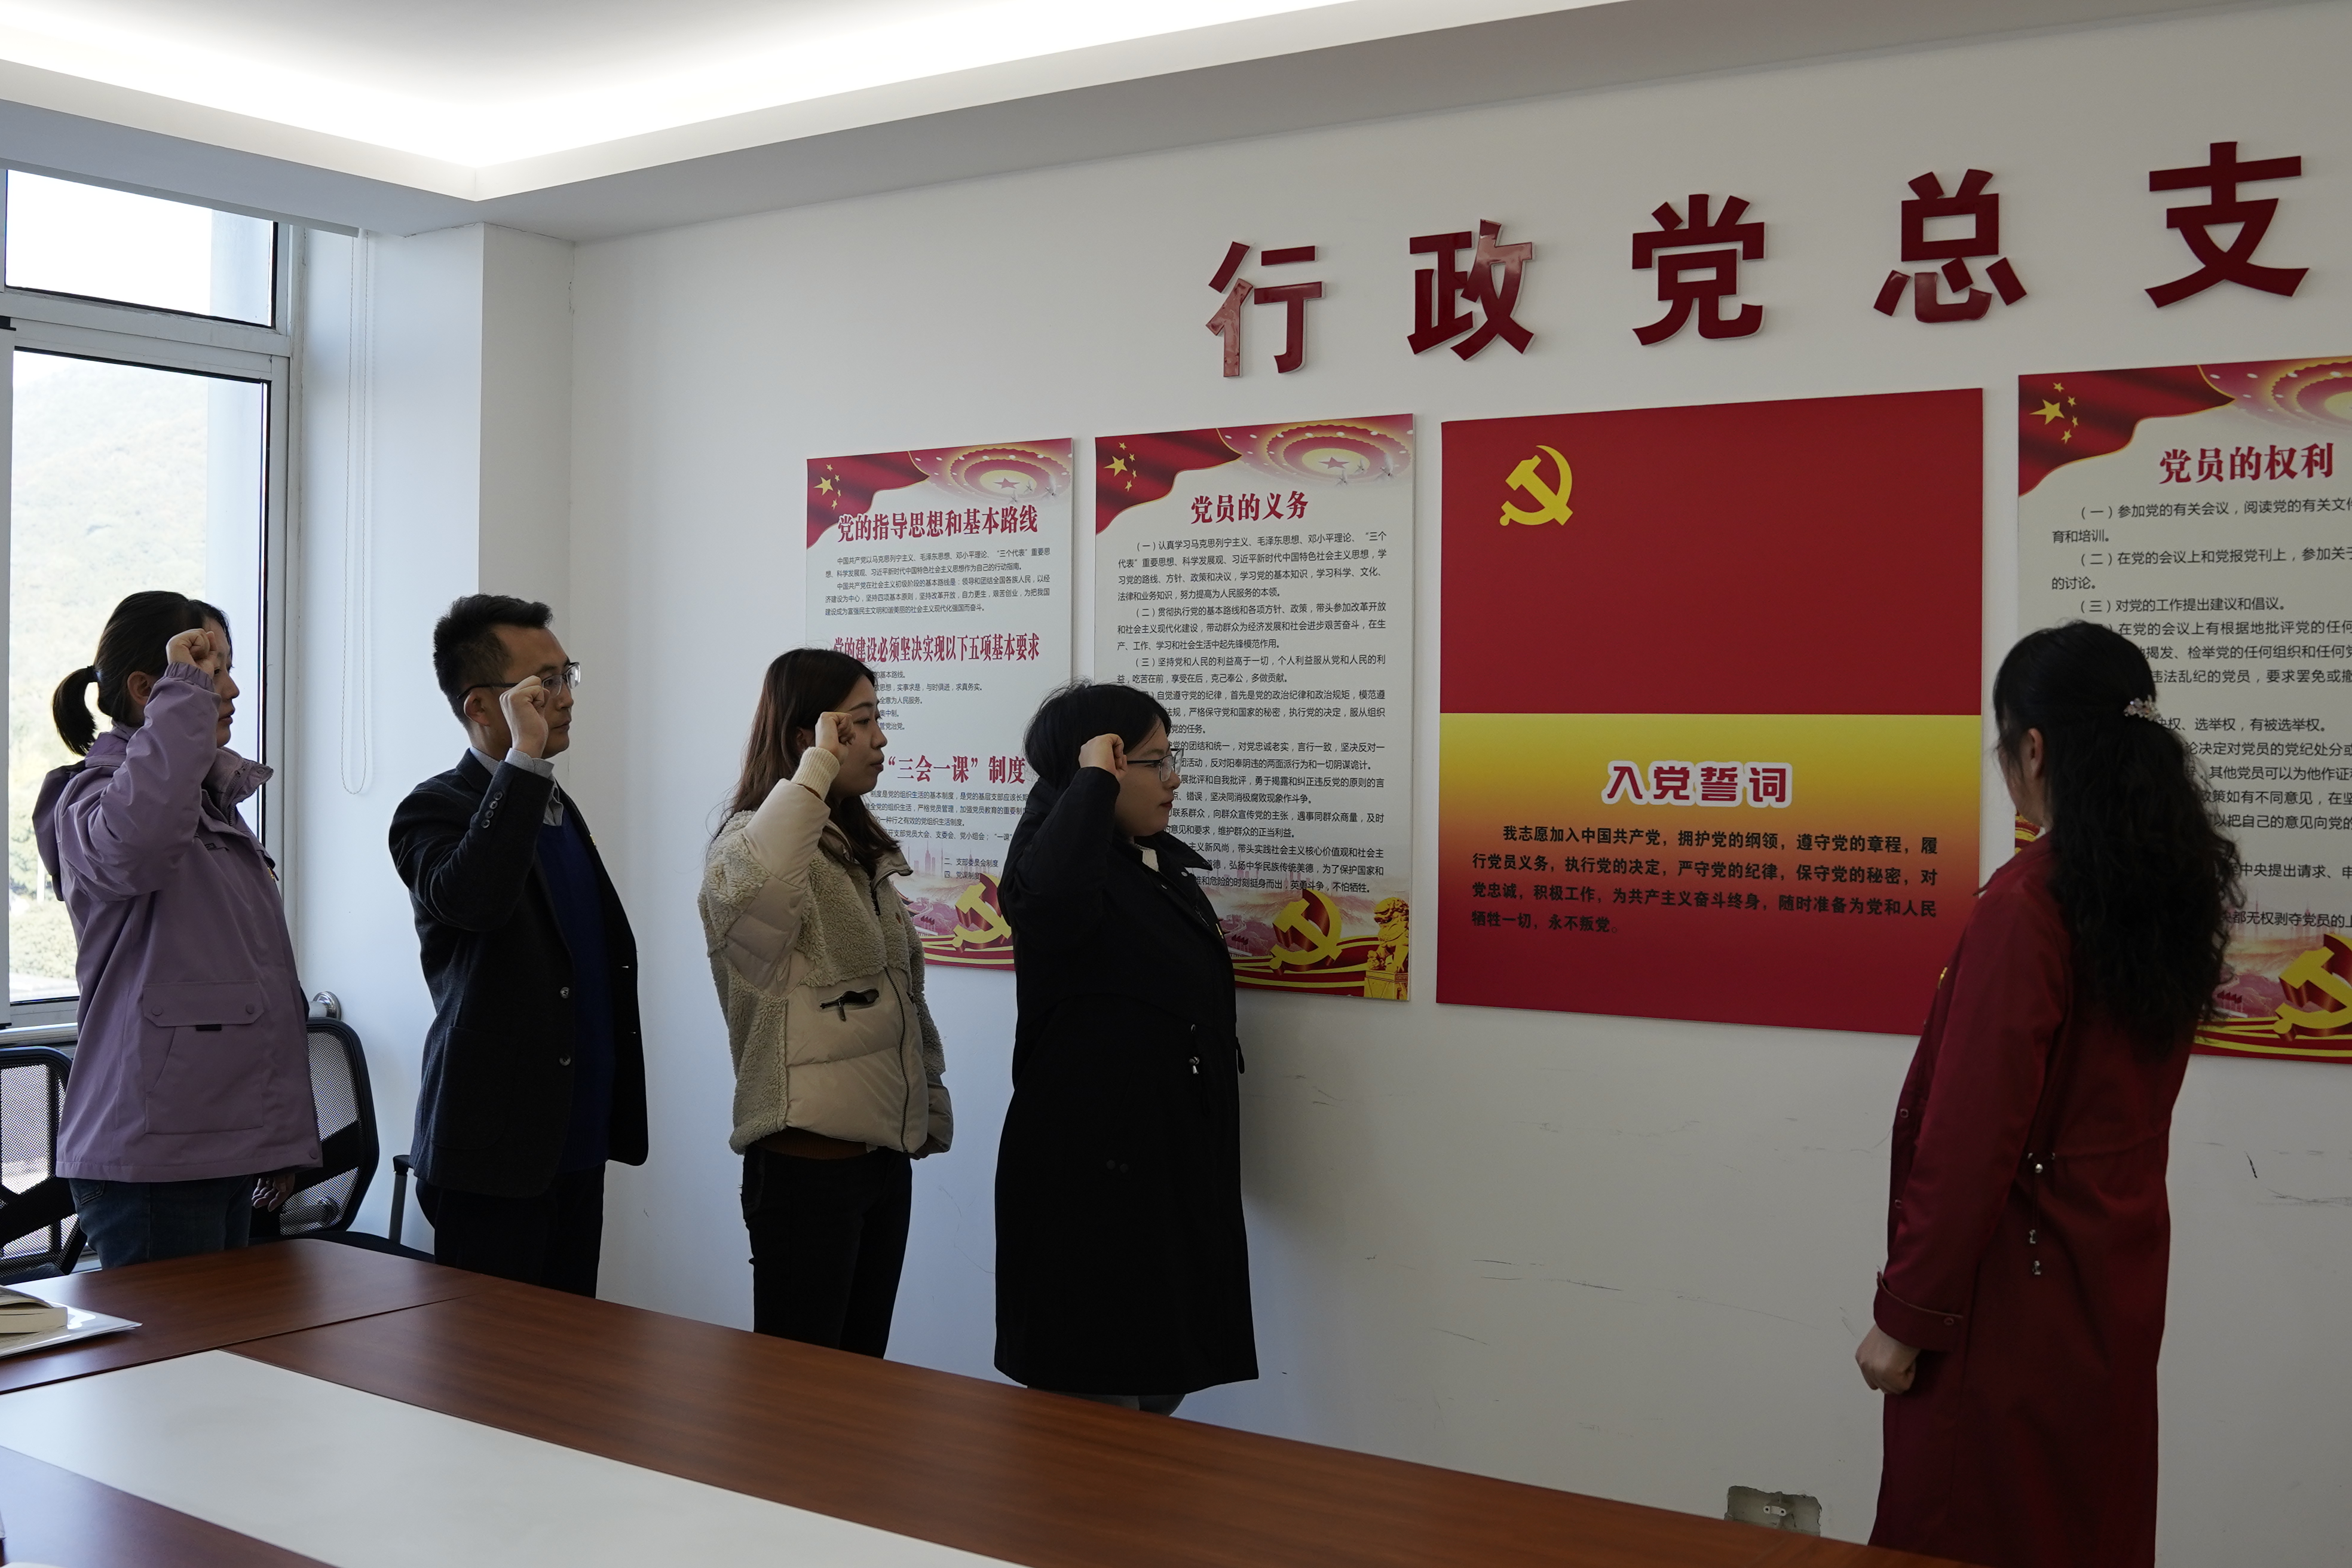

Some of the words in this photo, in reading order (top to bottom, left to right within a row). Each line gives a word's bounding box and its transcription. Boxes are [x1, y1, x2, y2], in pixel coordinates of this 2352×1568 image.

[1205, 142, 2310, 378] 行政党总支
[2158, 442, 2334, 484] 党员的权利
[838, 504, 1038, 543] 党的指导思想和基本路线
[1190, 491, 1309, 524] 党员的义务
[2051, 529, 2109, 544] 育和培训。
[2051, 576, 2096, 590] 的讨论。
[1606, 765, 1787, 804] 入党誓词
[1472, 910, 1618, 933] 牺牲一切，永不叛党。
